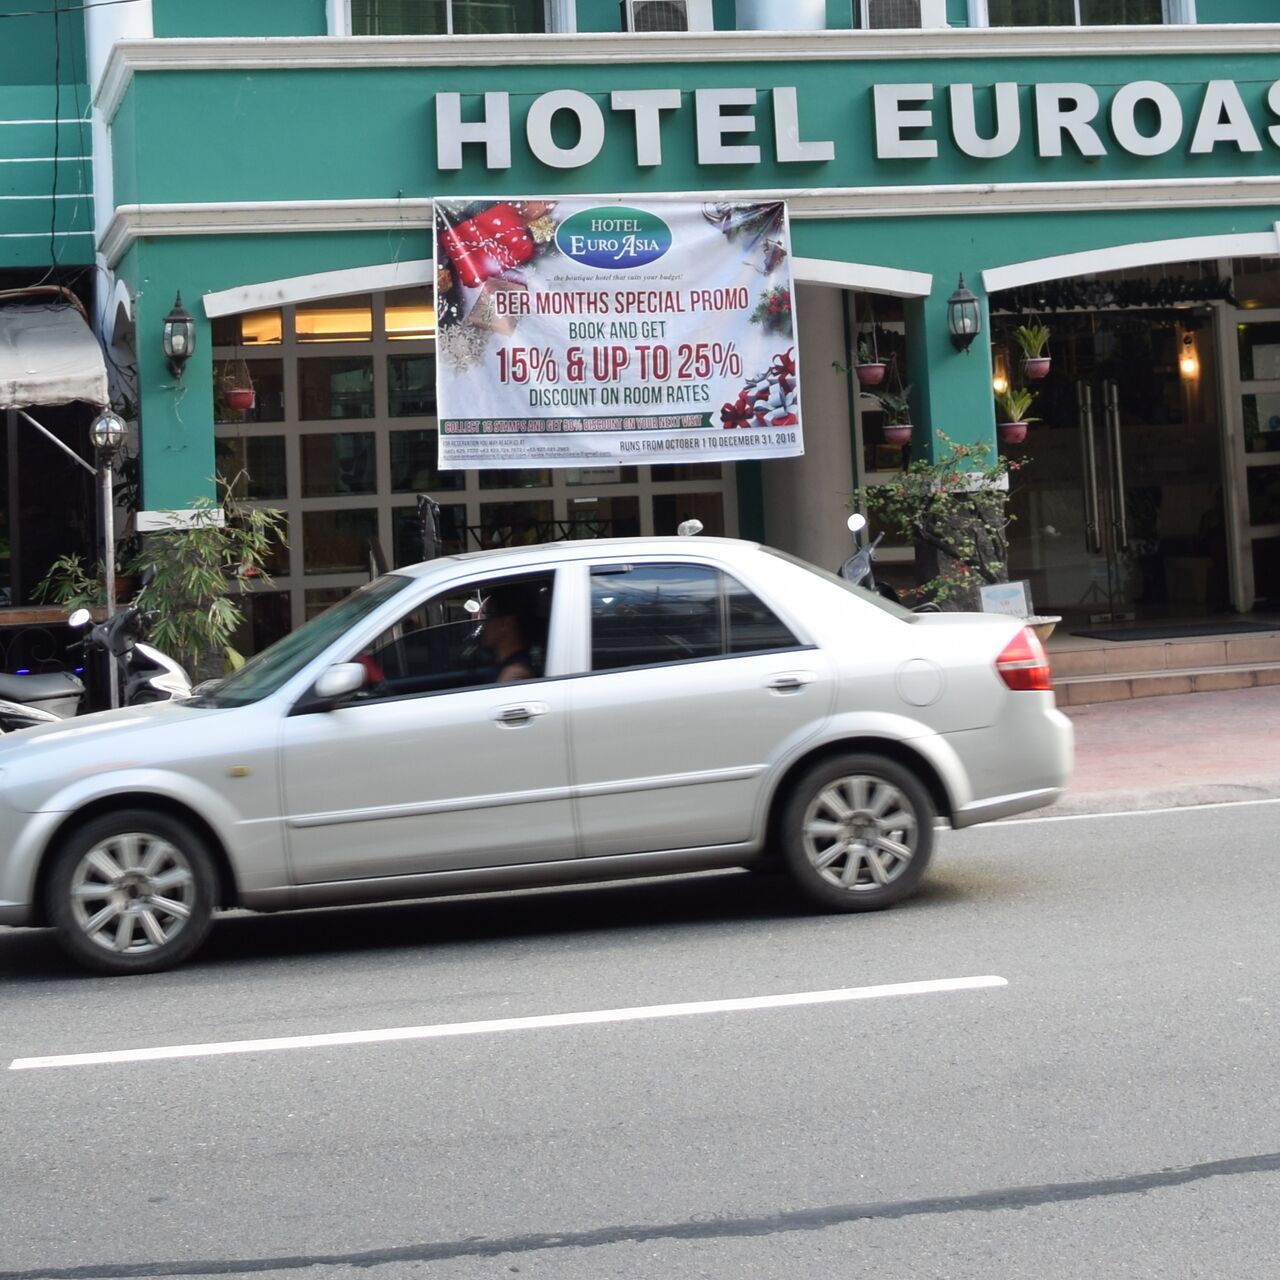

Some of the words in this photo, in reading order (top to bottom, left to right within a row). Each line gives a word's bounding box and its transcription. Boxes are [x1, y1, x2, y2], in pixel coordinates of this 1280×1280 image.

[435, 86, 836, 170] HOTEL
[591, 219, 642, 232] HOTEL
[496, 292, 530, 315] BER
[536, 291, 609, 314] MONTHS
[614, 290, 686, 314] SPECIAL
[690, 287, 749, 311] PROMO
[569, 322, 605, 339] BOOK
[609, 321, 637, 339] AND
[641, 321, 666, 338] GET
[496, 346, 558, 383] 15%
[567, 347, 585, 381] &
[592, 345, 629, 381] UP
[635, 344, 670, 380] TO
[677, 342, 742, 379] 25%
[529, 388, 596, 407] DISCOUNT
[601, 388, 619, 405] ON
[624, 387, 663, 405] ROOM
[667, 384, 710, 403] RATES
[445, 420, 480, 433] COLLECT
[494, 419, 526, 433] STAMPS
[527, 419, 545, 432] AND
[546, 419, 562, 432] GET
[584, 417, 622, 431] DISCOUNT
[620, 441, 640, 452] RUNS
[642, 439, 664, 451] FROM
[665, 438, 700, 450] OCTOBER
[708, 437, 717, 447] TO
[719, 435, 760, 447] DECEMBER
[776, 432, 796, 444] 2018
